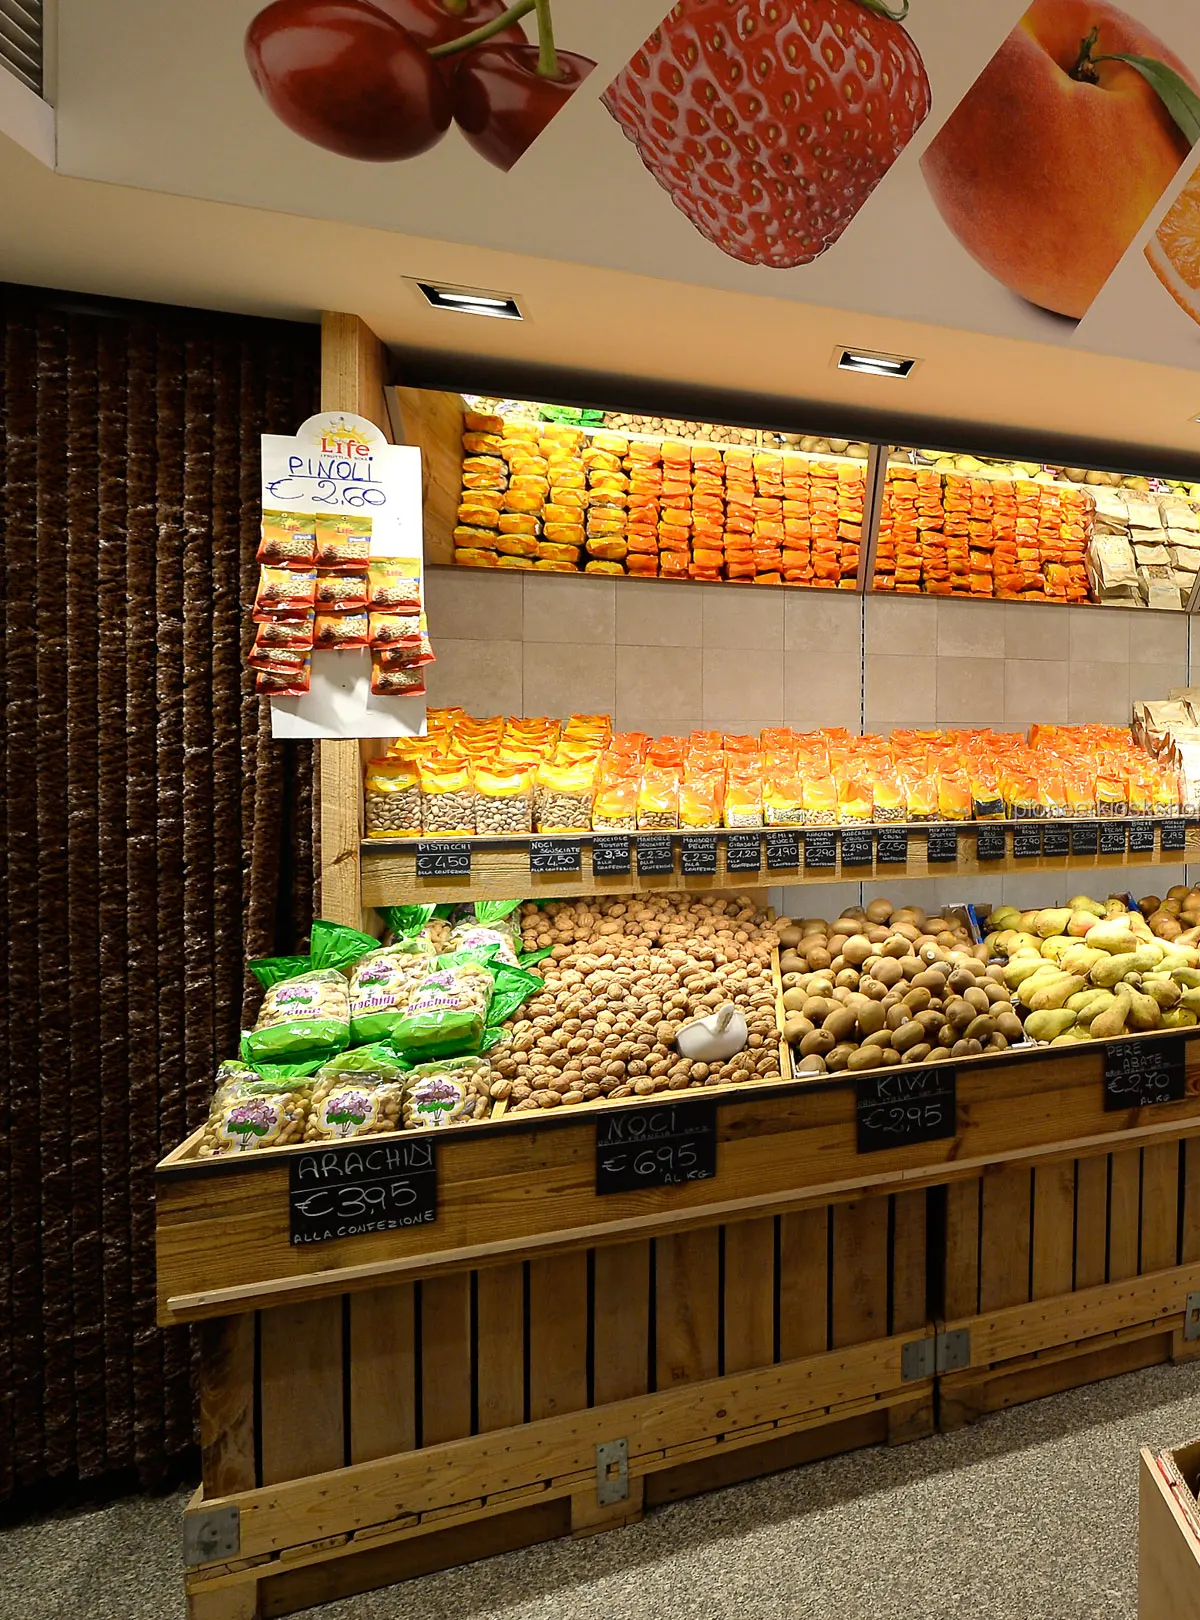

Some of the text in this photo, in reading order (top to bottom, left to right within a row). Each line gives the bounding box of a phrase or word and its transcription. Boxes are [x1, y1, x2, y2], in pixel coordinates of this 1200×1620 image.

[321, 438, 370, 458] Life
[289, 456, 373, 482] PINOLI
[418, 843, 471, 851] PISTACCHI
[532, 841, 552, 850] NOCI
[1105, 1042, 1141, 1059] PERE
[1123, 1053, 1162, 1070] ABATE
[877, 1068, 940, 1097] KIWI
[608, 1105, 676, 1140] NOCI
[298, 1138, 433, 1179] ARACHIDI
[664, 1173, 681, 1183] AL
[294, 1210, 435, 1245] ALLA CONFEZIONE
